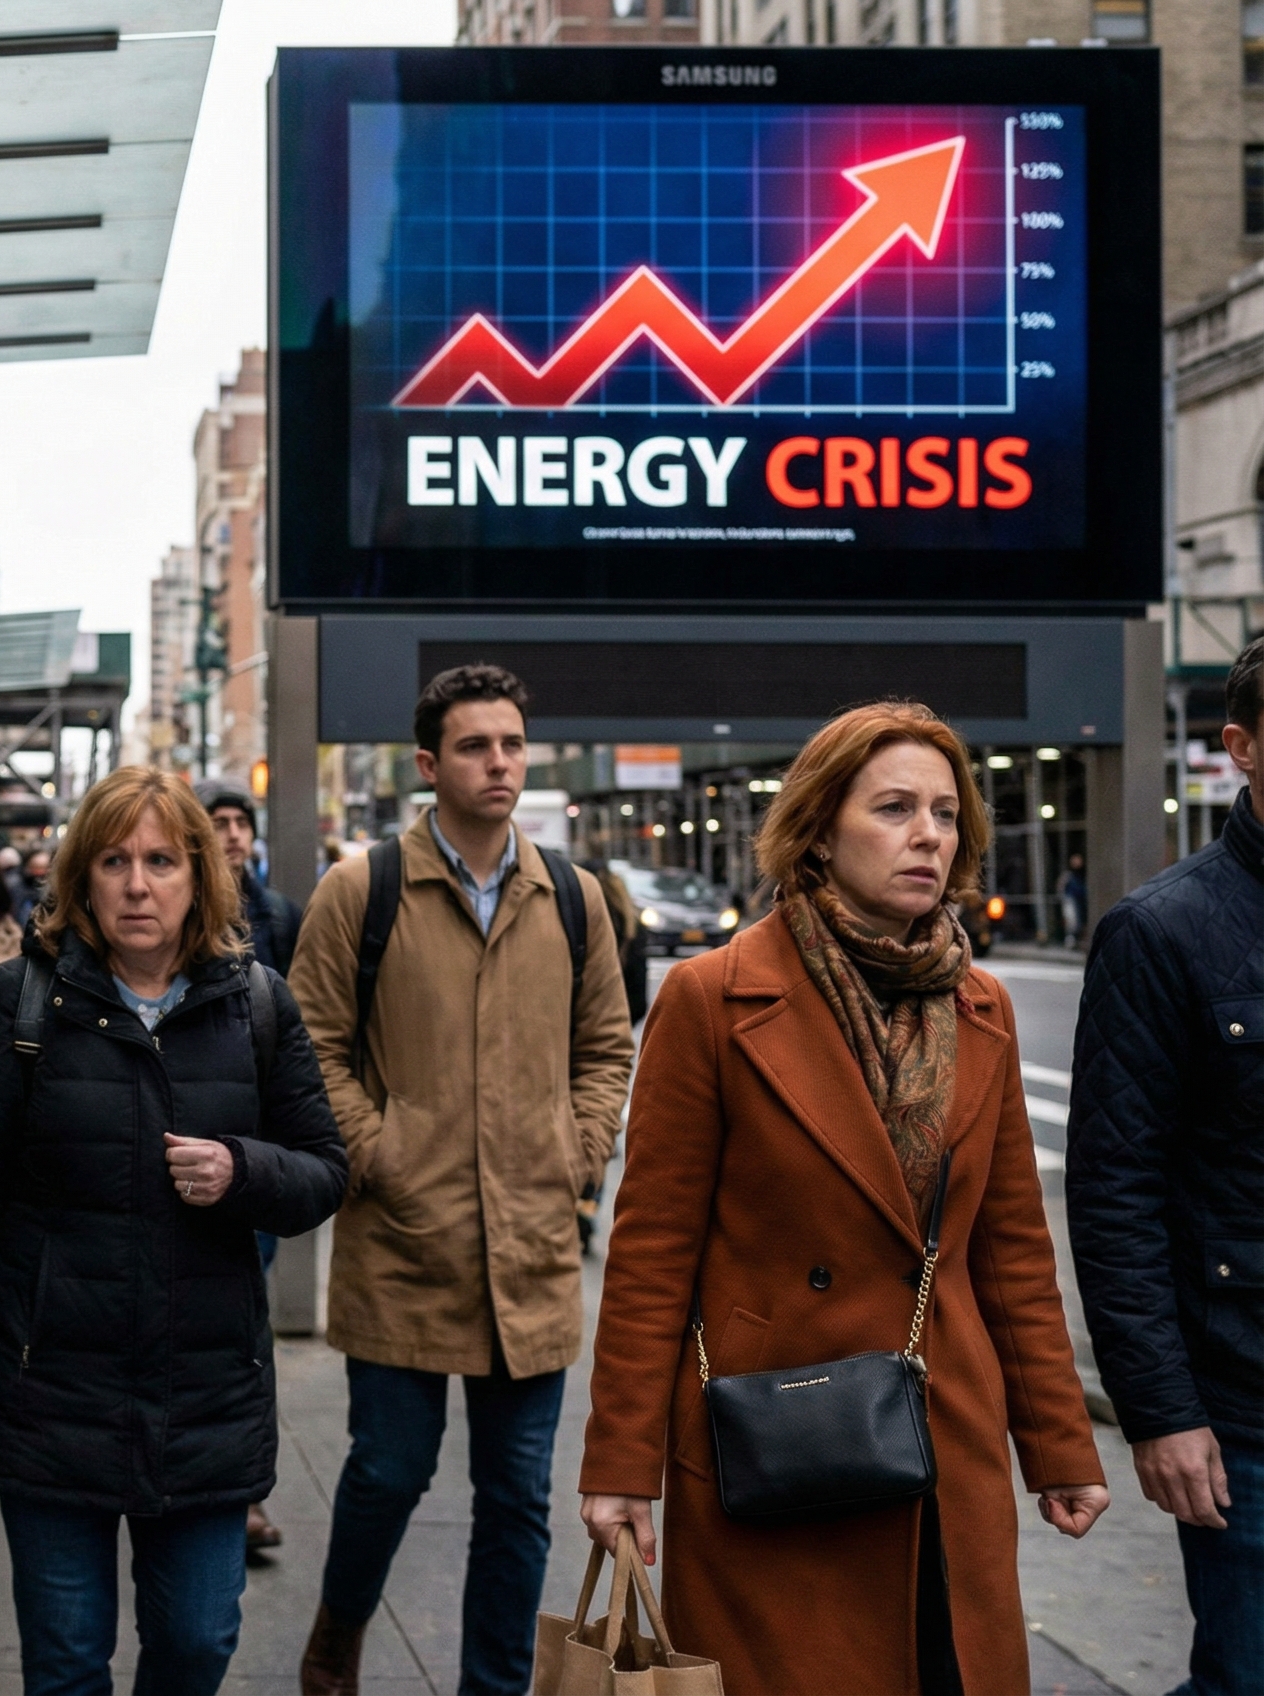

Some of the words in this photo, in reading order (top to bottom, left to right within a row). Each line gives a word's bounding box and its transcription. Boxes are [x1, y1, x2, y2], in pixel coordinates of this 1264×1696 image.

[661, 65, 777, 87] SAMSUNG
[1020, 161, 1064, 180] 125%
[1020, 211, 1065, 229] 100%
[1019, 261, 1056, 279] 75%
[1019, 311, 1056, 330] 50%
[1019, 360, 1056, 379] 25%
[407, 435, 747, 507] ENERGY
[765, 436, 1033, 508] CRISIS
